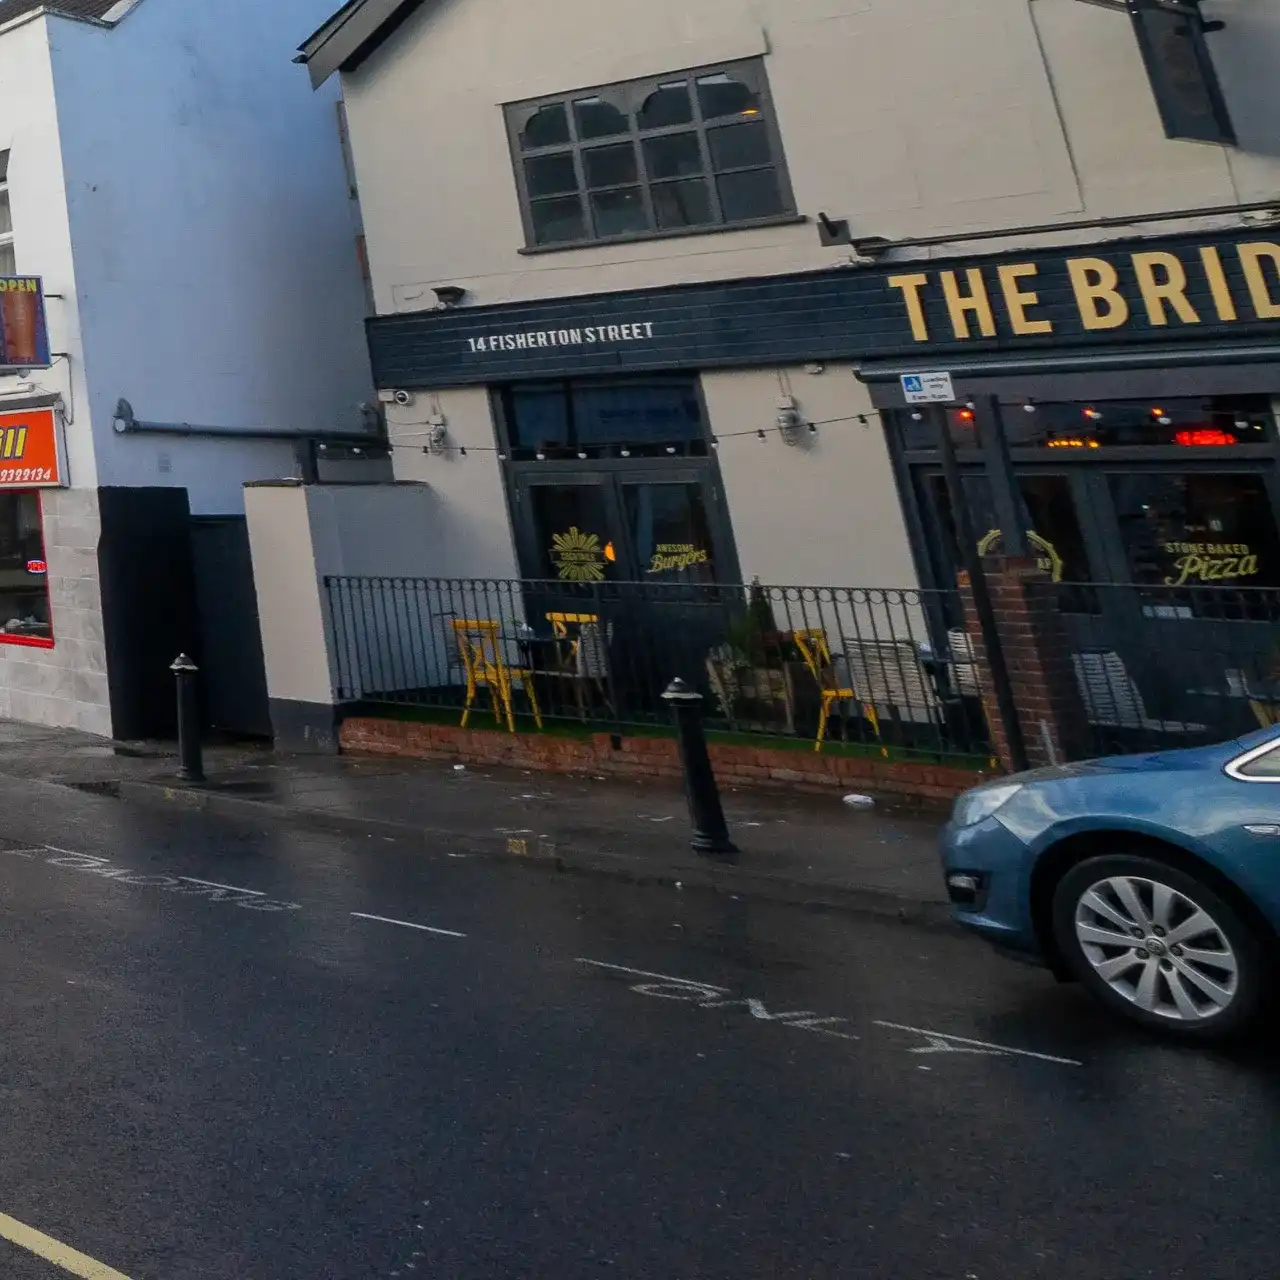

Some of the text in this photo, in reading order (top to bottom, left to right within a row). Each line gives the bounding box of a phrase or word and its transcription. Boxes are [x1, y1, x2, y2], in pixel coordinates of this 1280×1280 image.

[887, 262, 1053, 341] THE
[468, 322, 653, 353] 14 FISHERTON STREET
[651, 549, 707, 571] Burgers
[1165, 542, 1250, 555] STONE BAKED
[1164, 554, 1258, 587] Pizza
